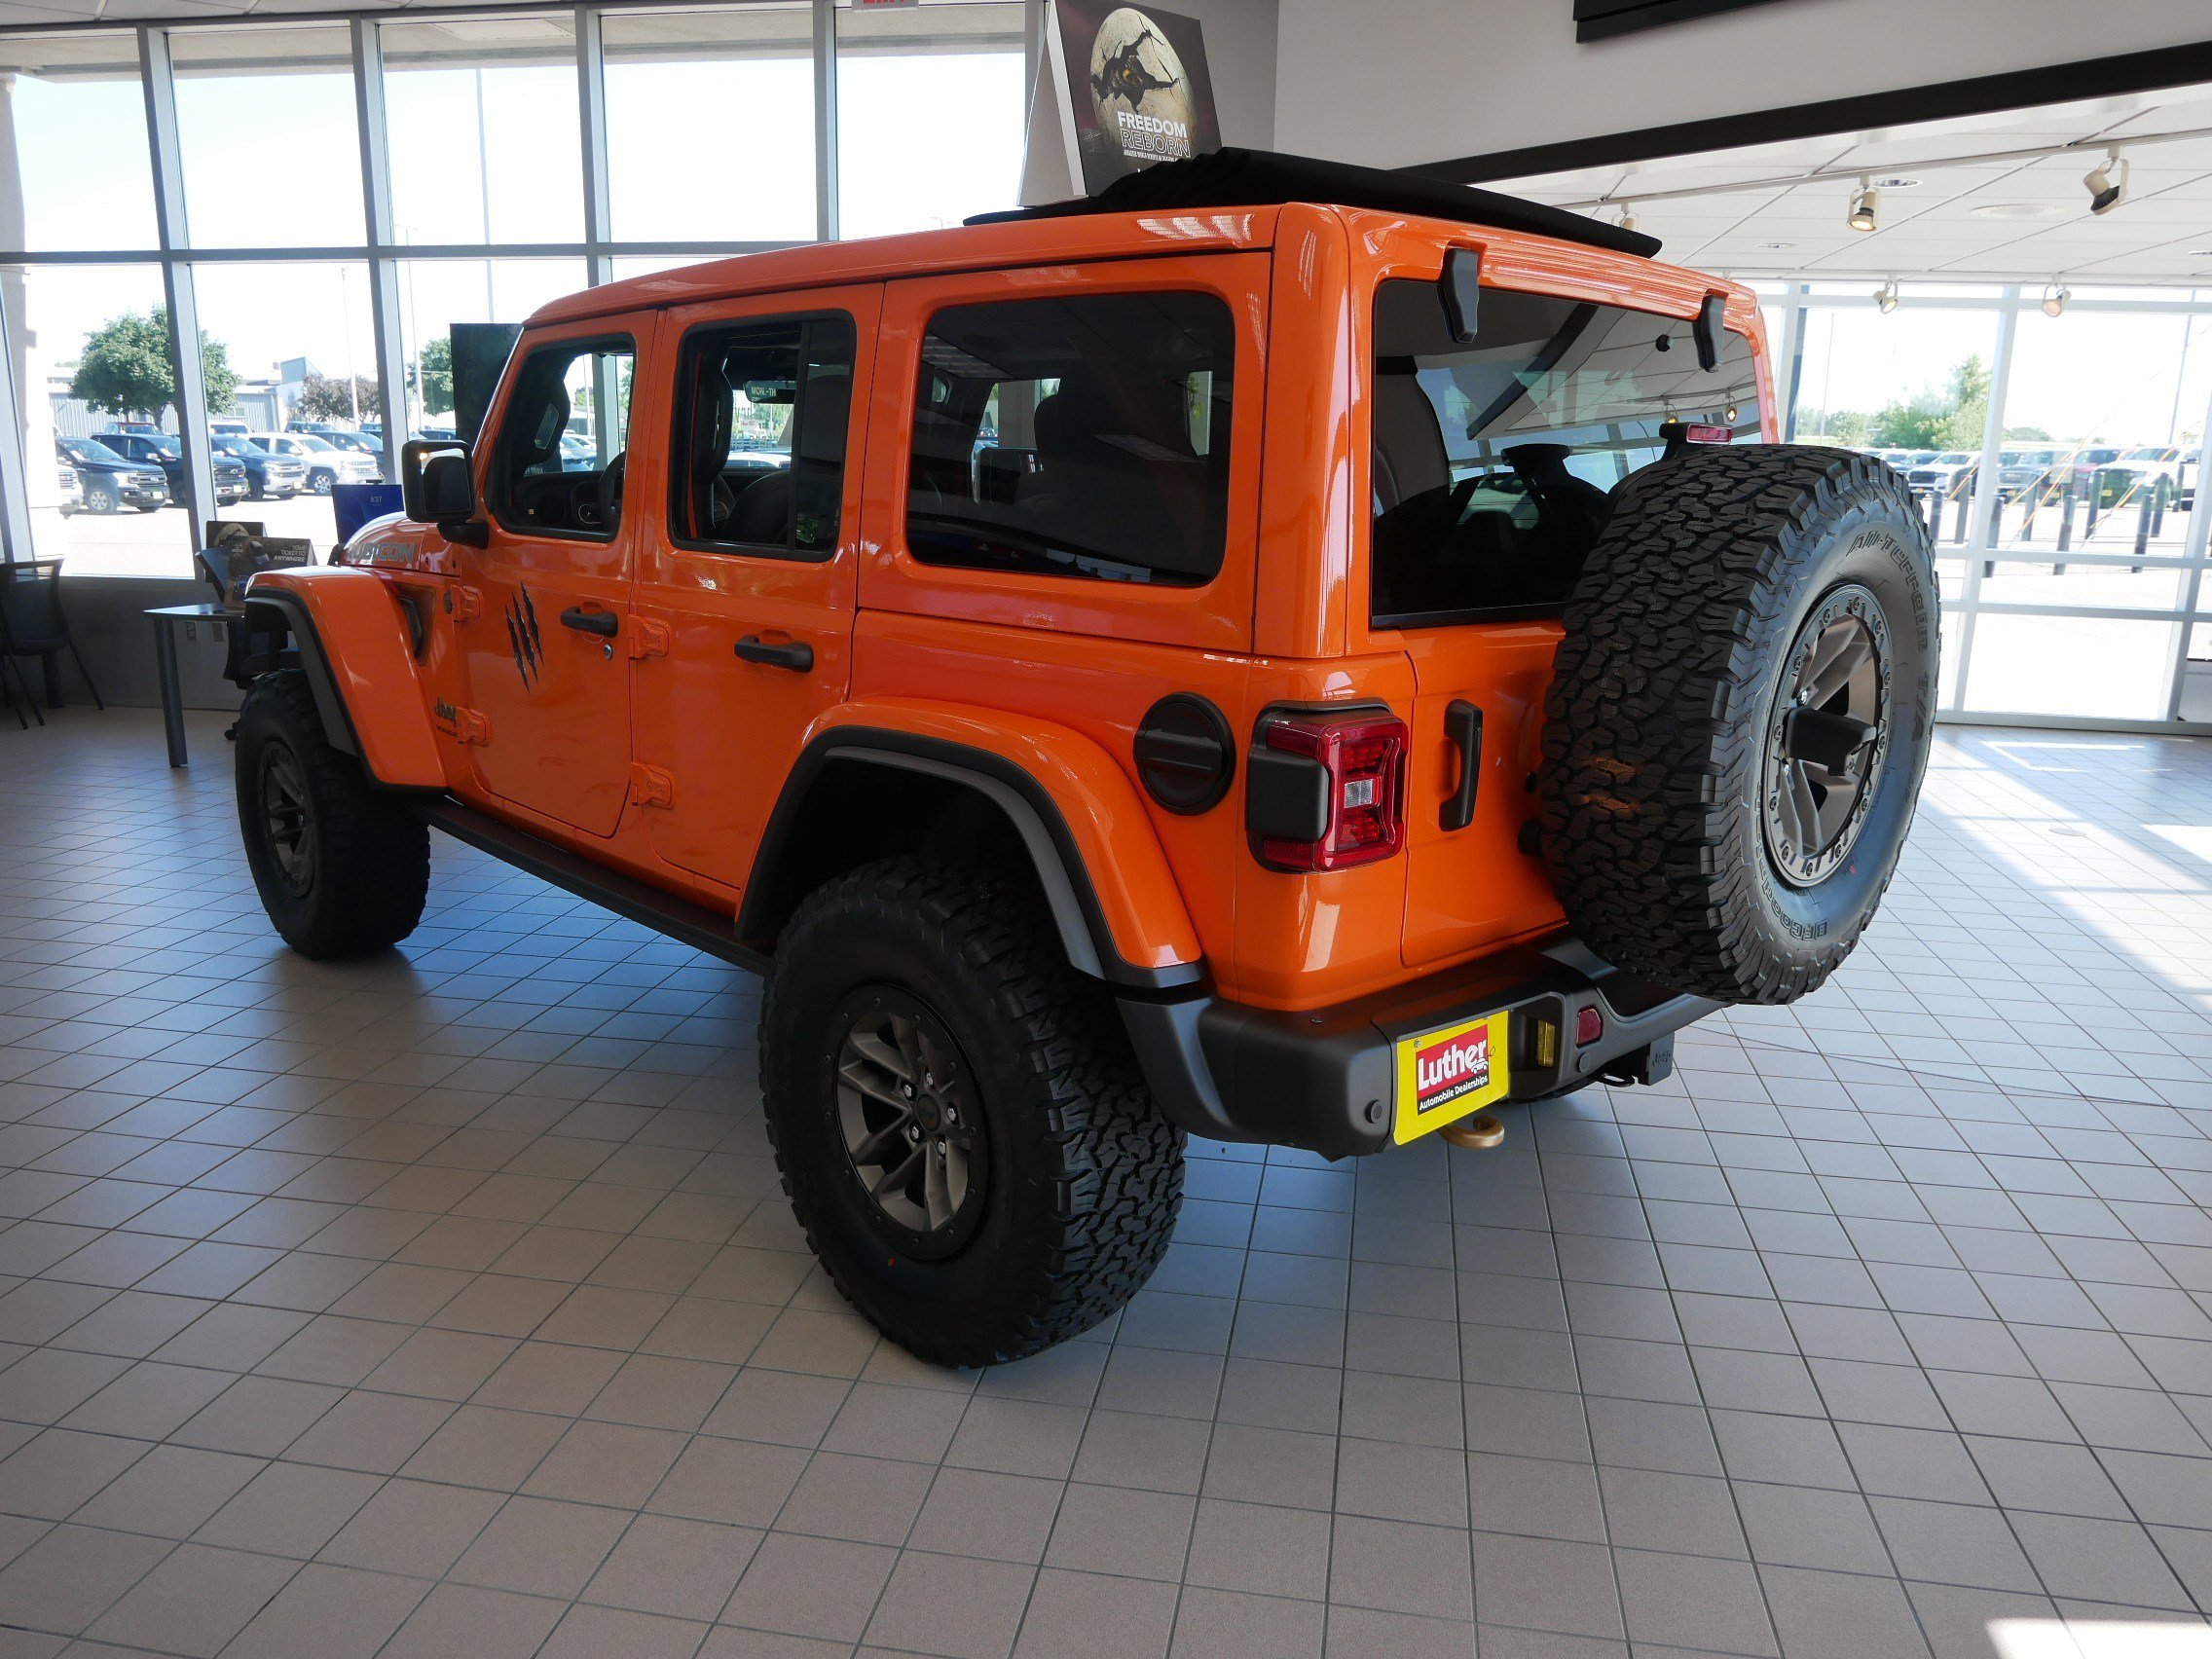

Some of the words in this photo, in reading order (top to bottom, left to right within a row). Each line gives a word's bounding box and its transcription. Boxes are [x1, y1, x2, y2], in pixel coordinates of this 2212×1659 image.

[1117, 111, 1187, 138] FREEDOM
[1120, 129, 1191, 158] REBORN
[1418, 1039, 1488, 1091] Luther
[1419, 1088, 1455, 1111] Automobile
[1455, 1074, 1489, 1096] Dealerships
